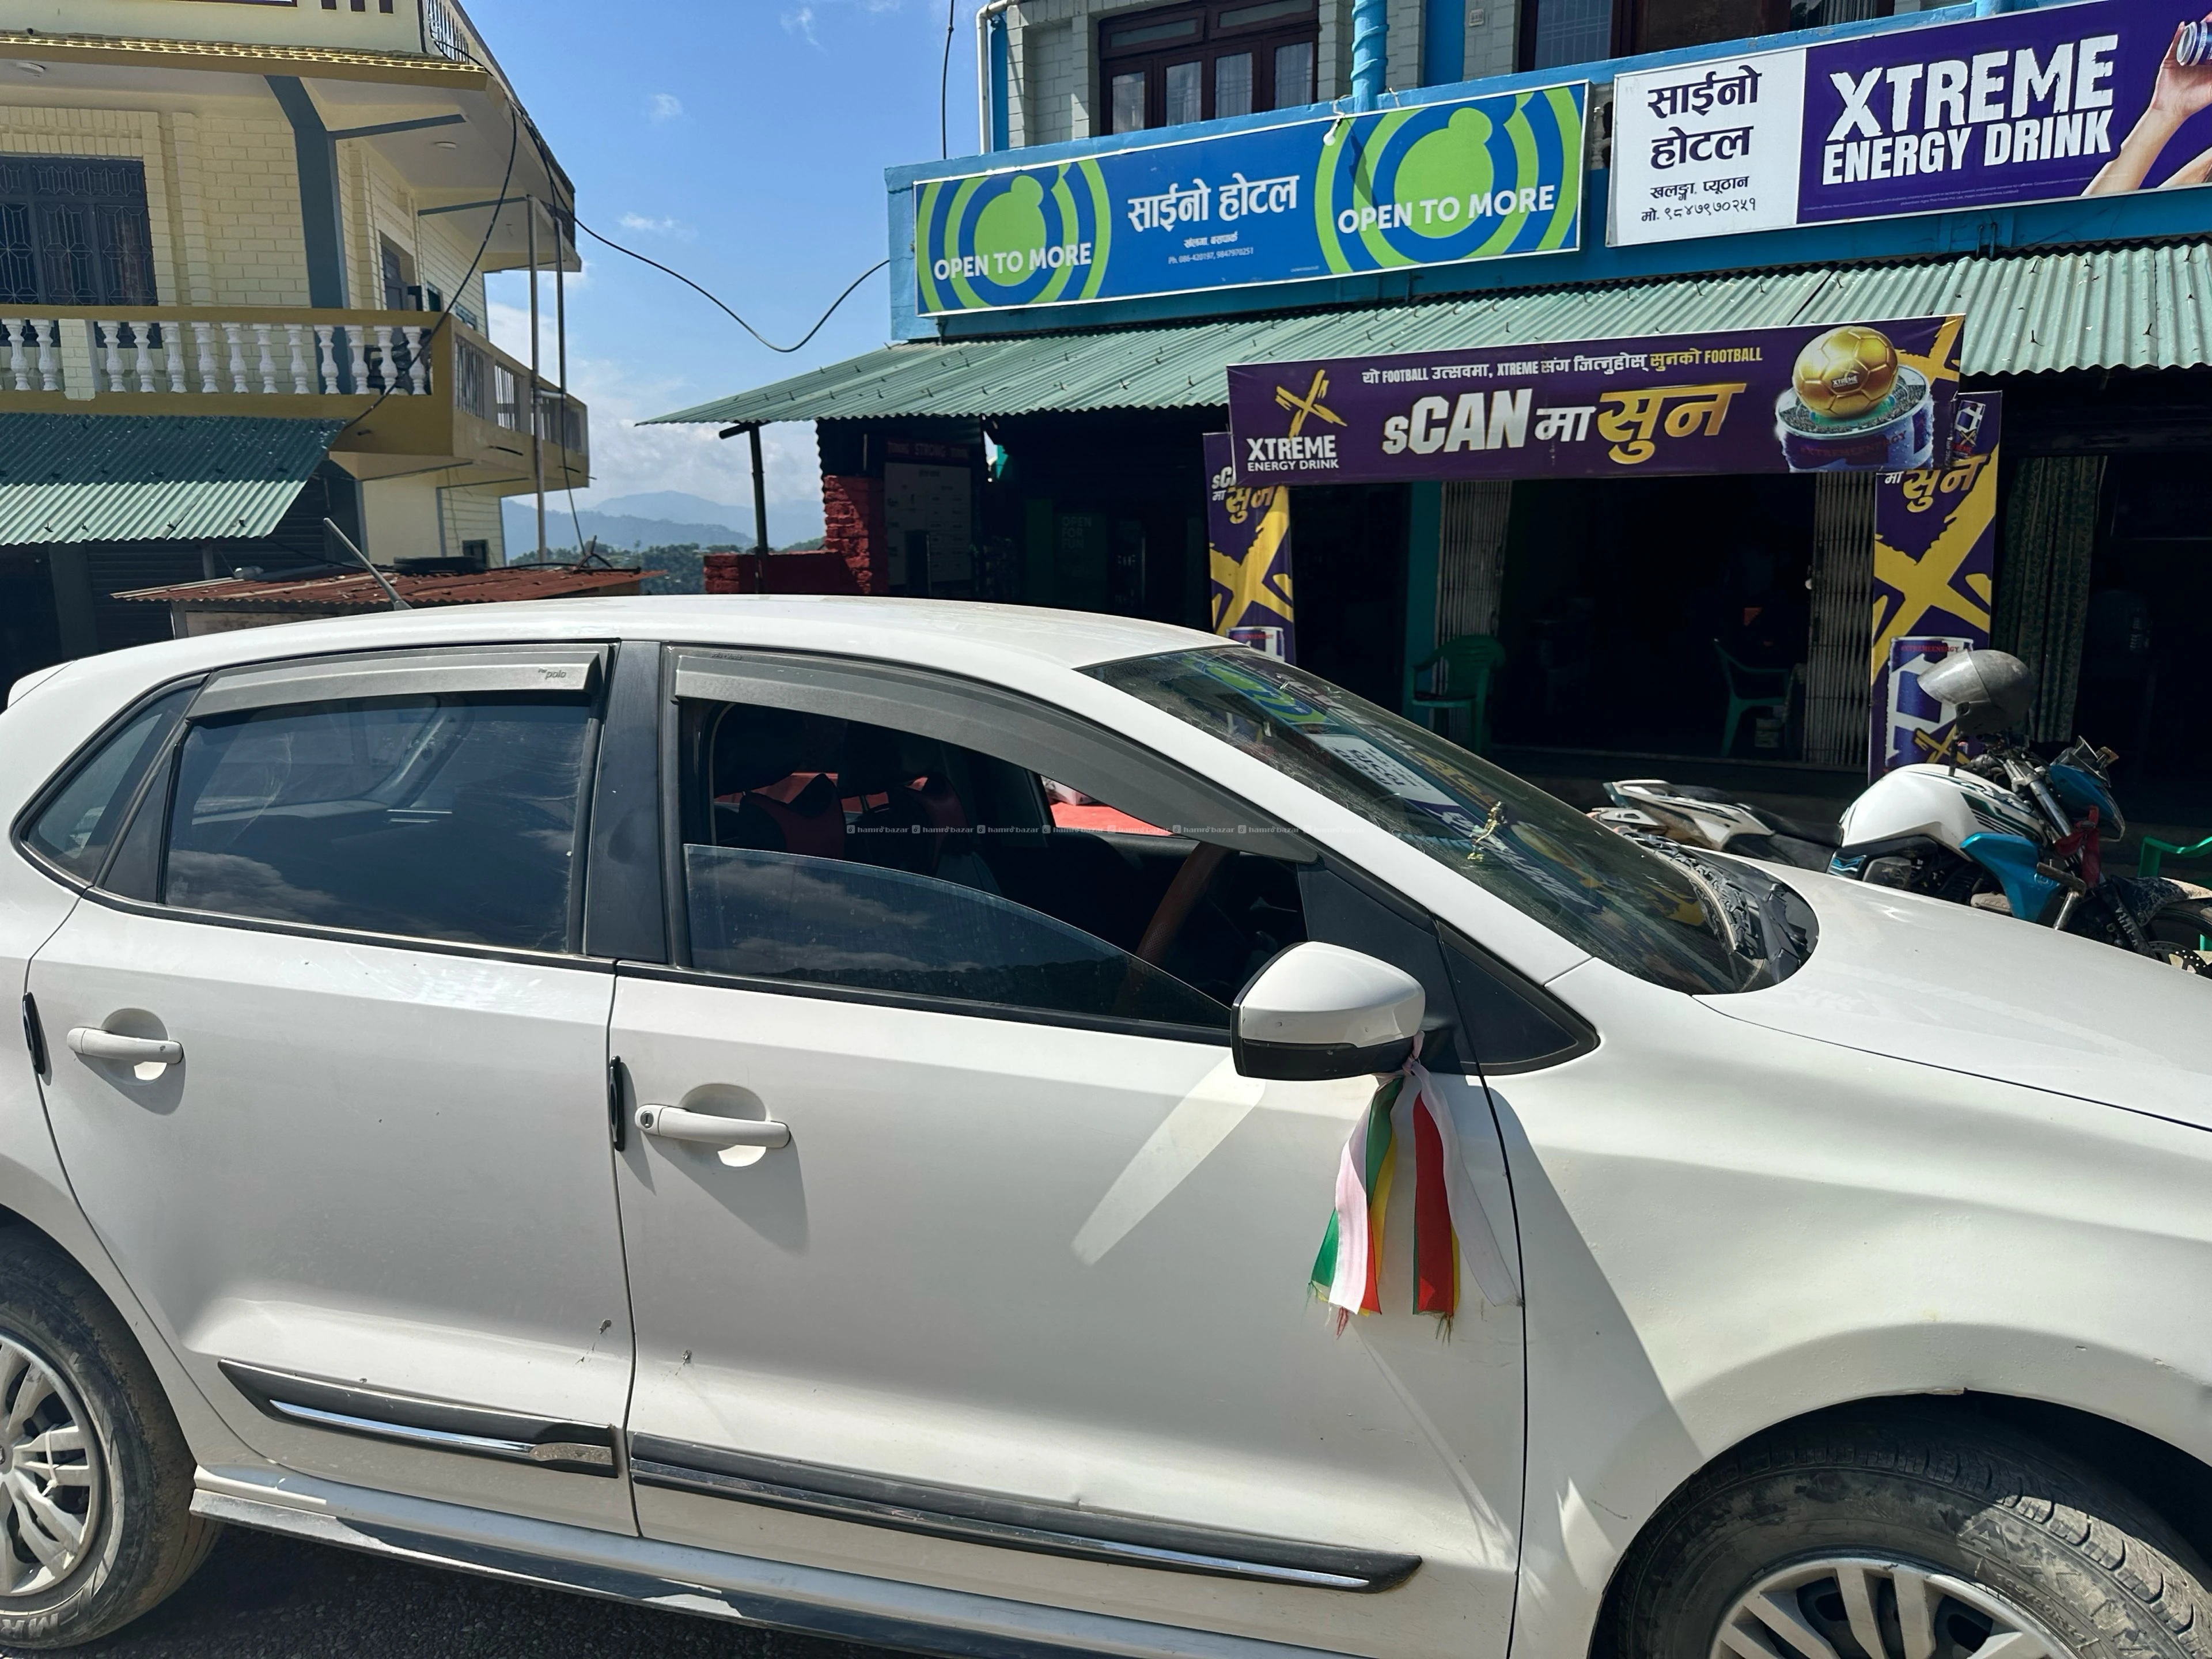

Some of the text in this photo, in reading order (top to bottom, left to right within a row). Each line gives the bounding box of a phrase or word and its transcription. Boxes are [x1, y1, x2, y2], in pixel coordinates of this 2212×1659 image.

[1647, 65, 1762, 119] साईनो
[1826, 34, 2119, 142] XTREME
[1650, 126, 1754, 169] होटल
[1822, 109, 2114, 185] ENERGY DRINK
[1127, 172, 1300, 232] साईनो होटल
[1338, 184, 1555, 233] OPEN TO MORE
[934, 243, 1092, 281] OPEN TO MORE
[1362, 369, 1381, 384] यो
[1382, 368, 1429, 383] FOOTBALL
[1497, 361, 1539, 376] XTREME
[1650, 348, 1702, 372] सुनको
[1704, 347, 1763, 364] FOOTBALL
[1832, 376, 1858, 387] XTREME
[1382, 383, 1747, 464] sCAN मा सुन
[1246, 435, 1336, 461] XTREME
[1247, 459, 1339, 472] ENERGY DRINK
[545, 670, 567, 680] polo
